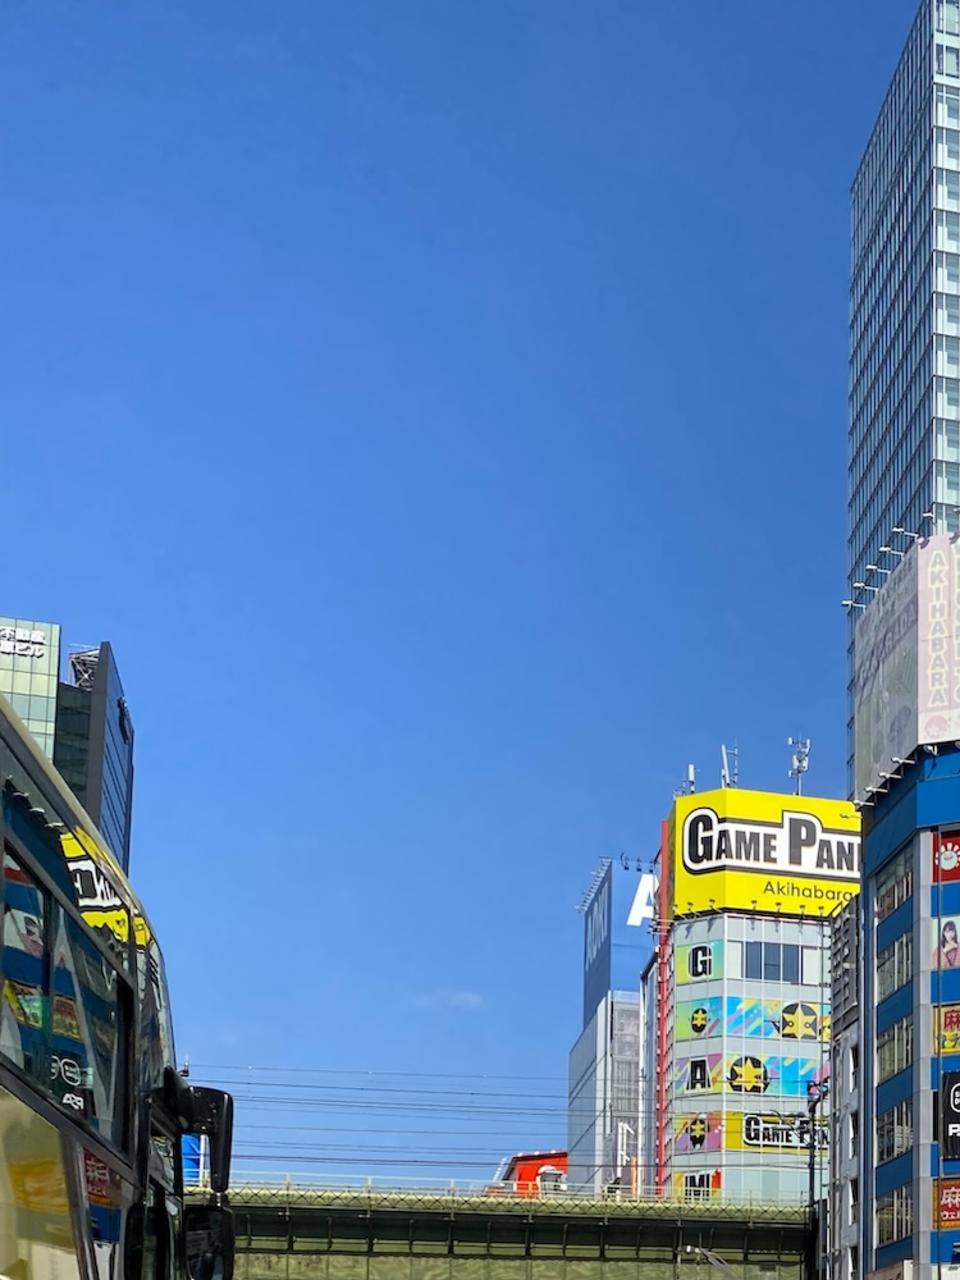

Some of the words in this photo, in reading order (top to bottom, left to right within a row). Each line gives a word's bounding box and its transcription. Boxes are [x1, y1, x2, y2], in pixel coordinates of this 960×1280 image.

[928, 551, 949, 706] AKIHABARA
[688, 813, 778, 864] GAME
[763, 881, 855, 902] Akihabara
